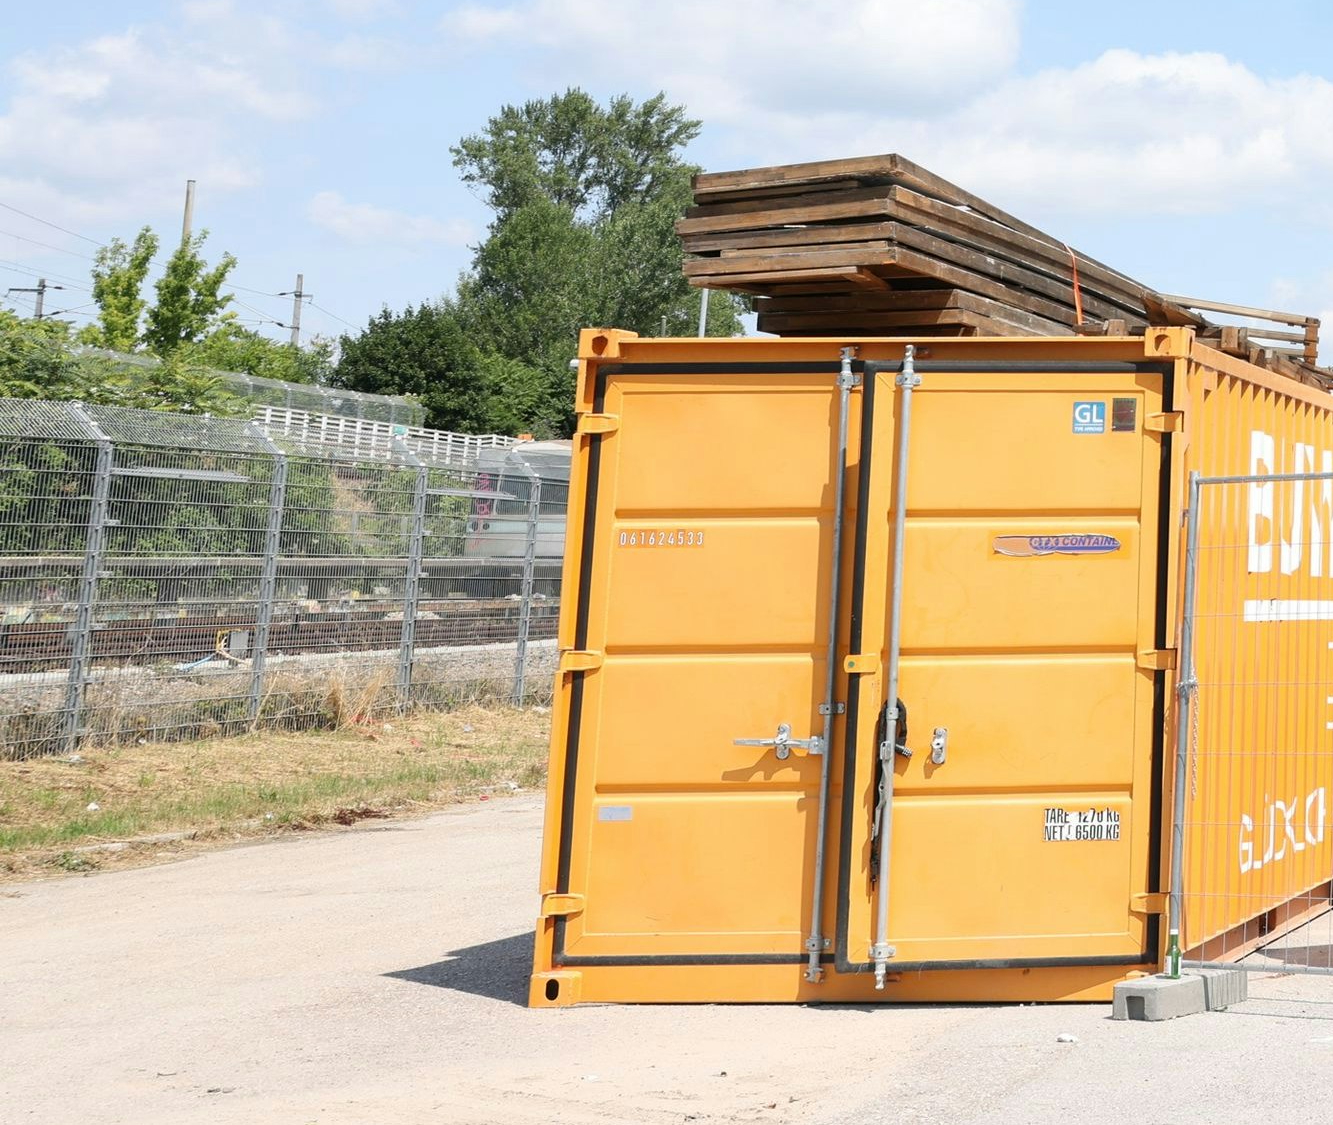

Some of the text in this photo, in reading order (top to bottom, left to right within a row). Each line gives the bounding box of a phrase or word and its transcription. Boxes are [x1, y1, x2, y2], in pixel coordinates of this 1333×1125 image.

[1075, 404, 1103, 423] GL
[620, 531, 704, 546] 061624533
[1045, 808, 1070, 824] TARE
[1106, 807, 1120, 823] KG
[1075, 824, 1103, 840] 6500
[1106, 824, 1120, 840] KG
